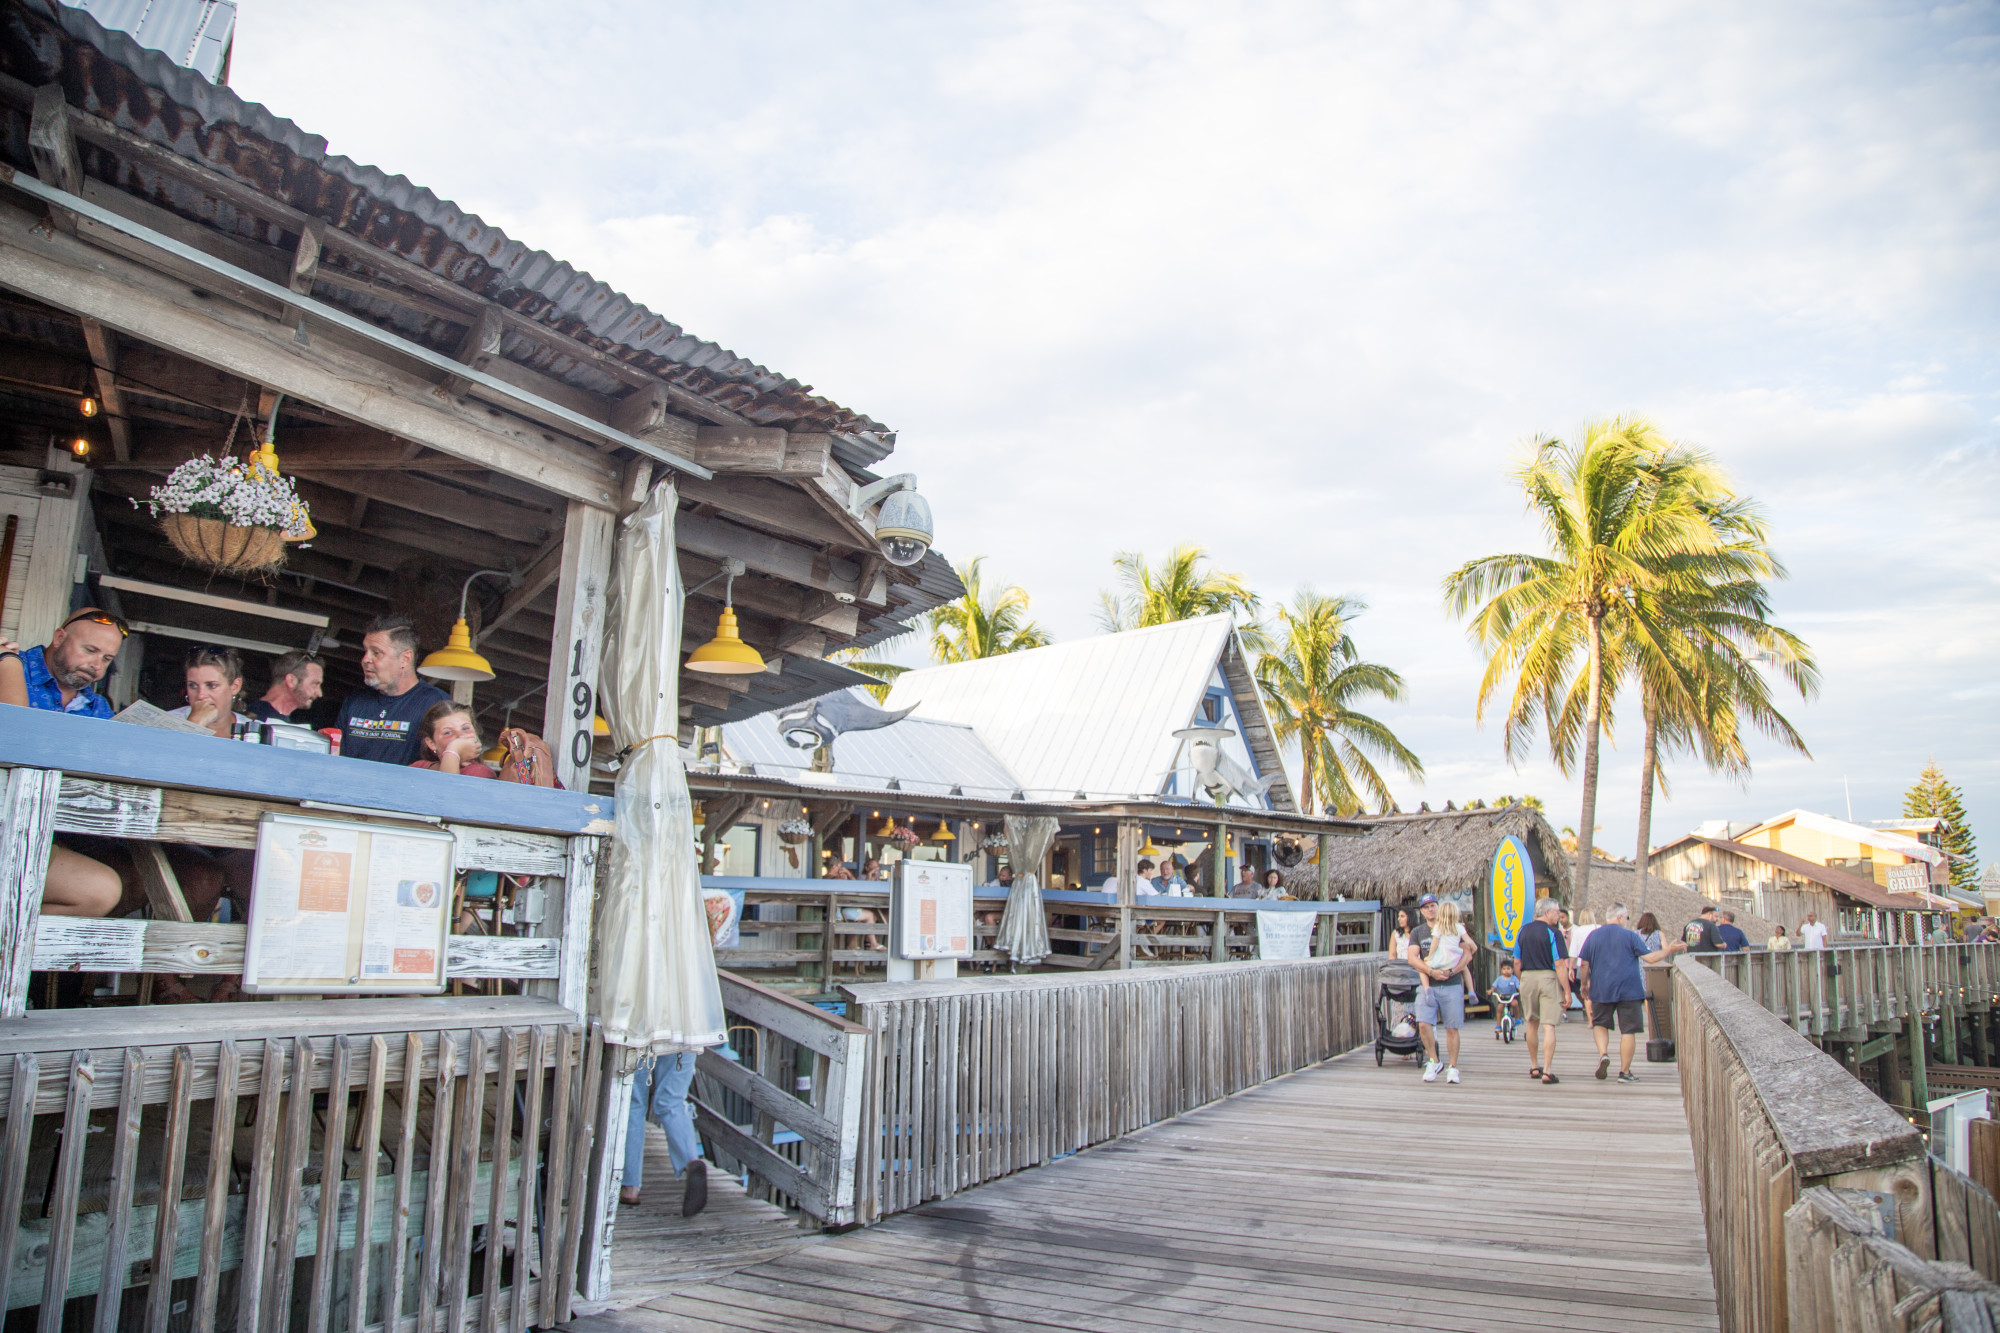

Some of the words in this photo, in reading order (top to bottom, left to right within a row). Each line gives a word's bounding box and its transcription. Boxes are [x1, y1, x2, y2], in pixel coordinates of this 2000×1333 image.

[571, 639, 592, 768] 190
[1887, 868, 1924, 878] BOARDWALK
[1890, 876, 1927, 890] GRILL
